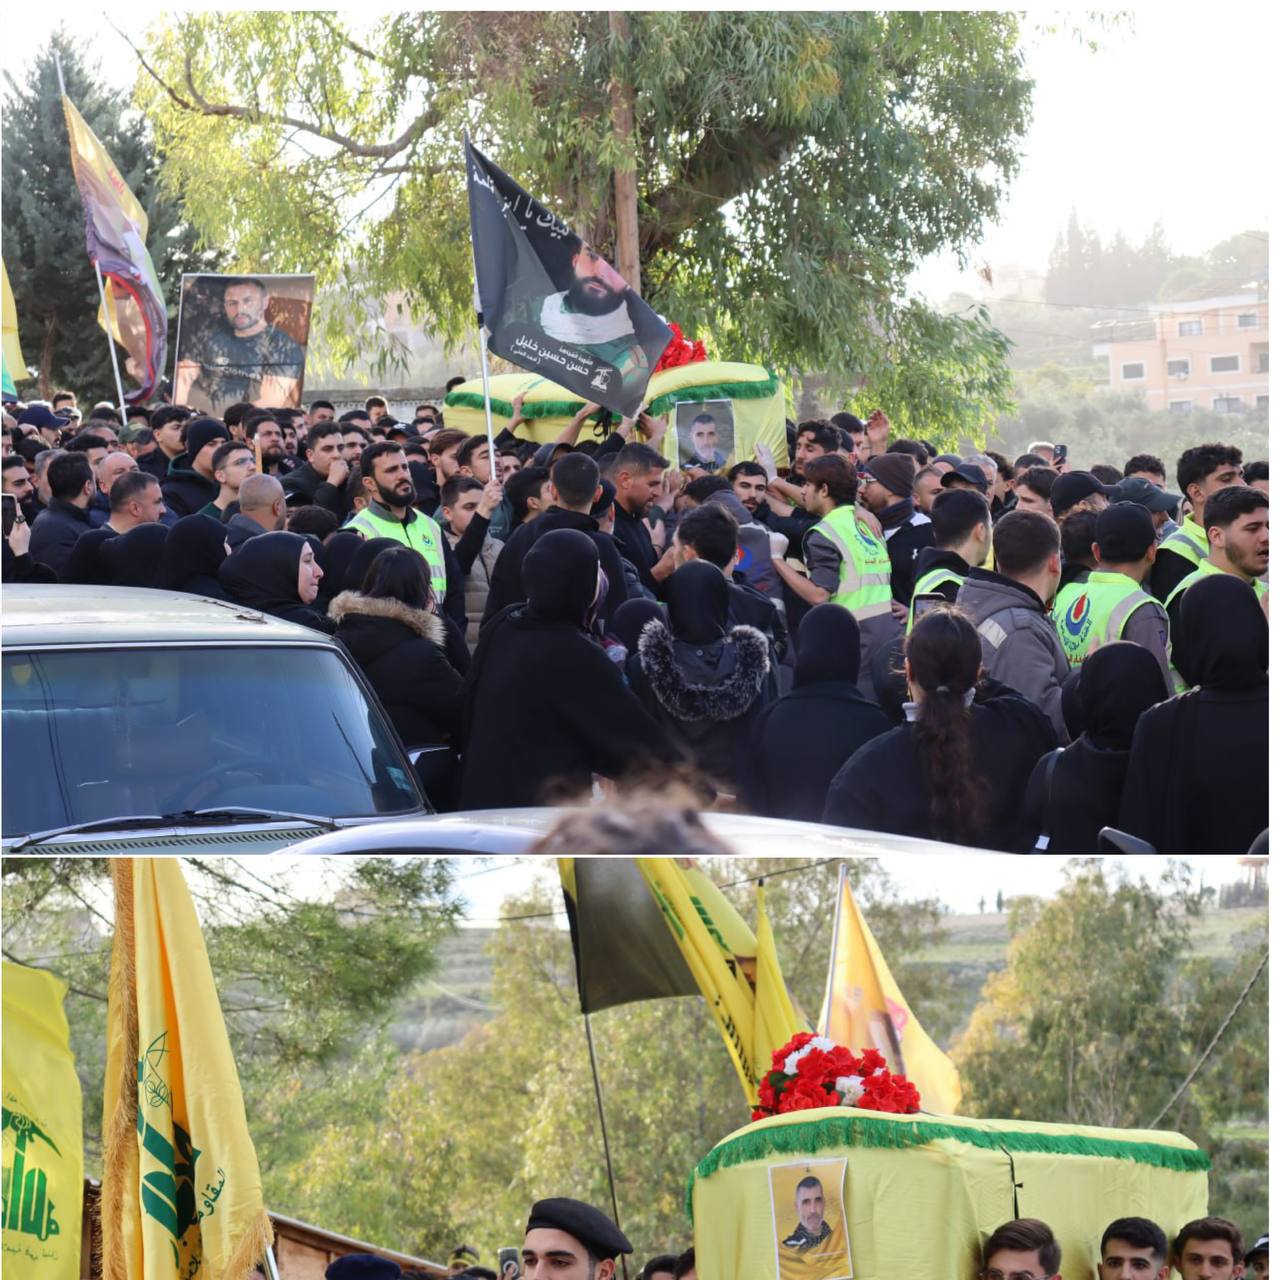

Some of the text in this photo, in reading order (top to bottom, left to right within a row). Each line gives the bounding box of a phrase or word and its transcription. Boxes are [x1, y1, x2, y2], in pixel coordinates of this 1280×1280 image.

[515, 335, 539, 352] خليل
[538, 347, 567, 366] حسين
[566, 361, 590, 376] حسن
